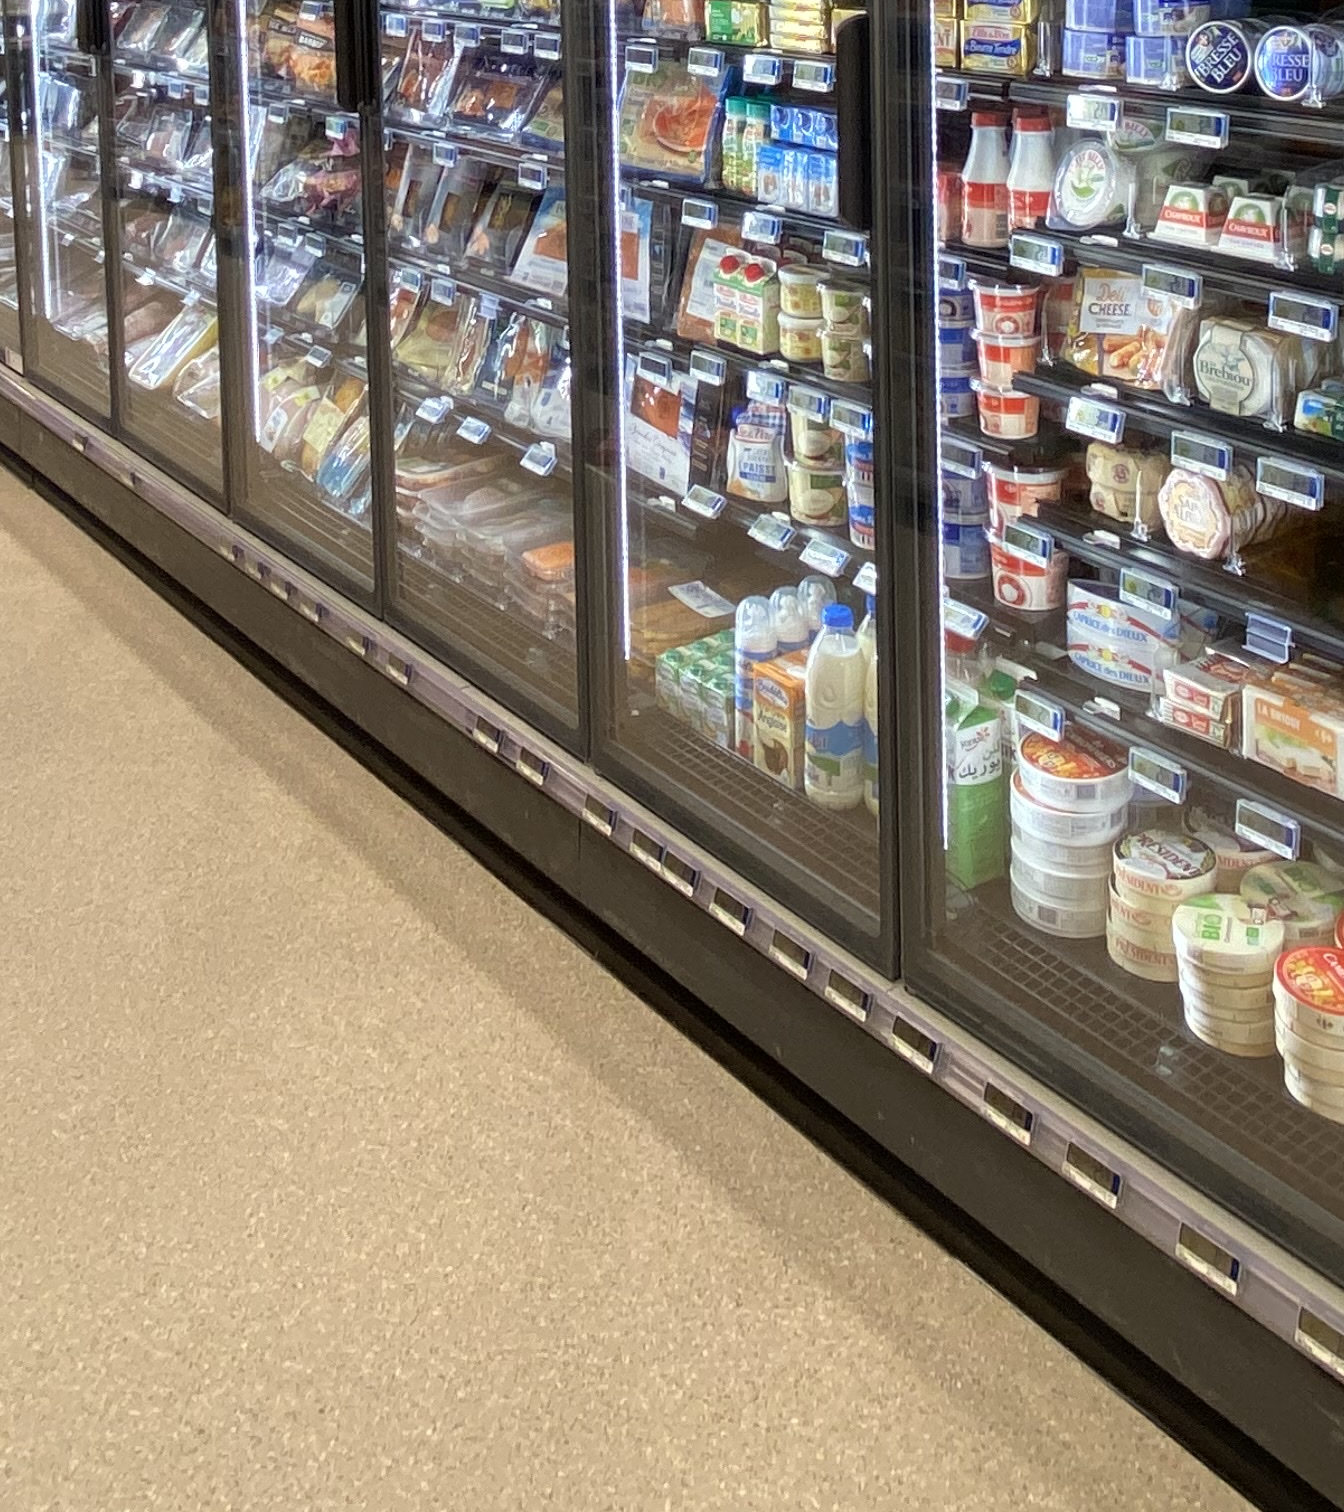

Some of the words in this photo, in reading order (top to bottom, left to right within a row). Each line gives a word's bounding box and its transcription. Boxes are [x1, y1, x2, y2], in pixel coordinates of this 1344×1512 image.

[1209, 48, 1243, 83] BLEU
[1088, 302, 1132, 317] CHEESE
[1201, 912, 1223, 942] BIO
